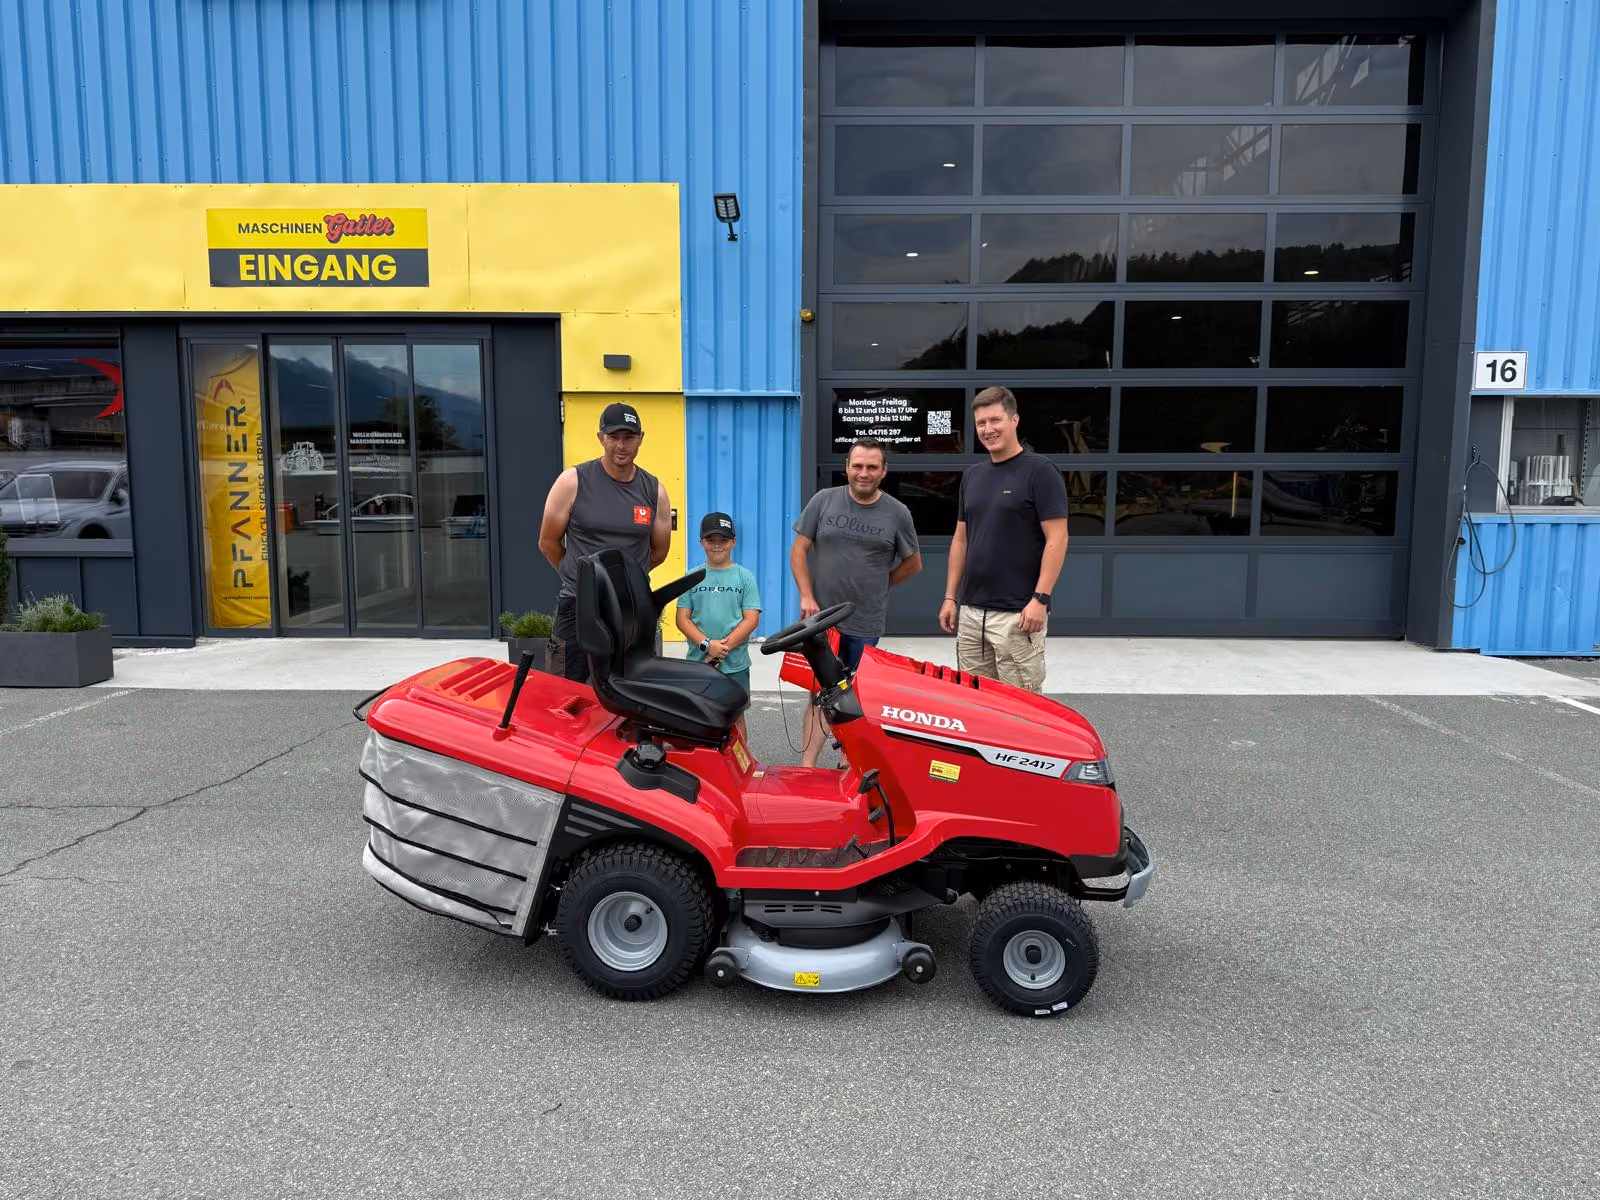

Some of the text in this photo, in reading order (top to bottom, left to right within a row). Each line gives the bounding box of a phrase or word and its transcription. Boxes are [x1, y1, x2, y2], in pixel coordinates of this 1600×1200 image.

[238, 213, 395, 244] MASCHINEN Gailer
[238, 254, 397, 281] EINGANG
[1486, 358, 1517, 383] 16
[848, 398, 876, 407] Montag
[882, 397, 908, 407] Freitag
[842, 415, 874, 423] Samstag
[826, 514, 885, 535] s.Oliver
[690, 586, 742, 594] JORDAN
[881, 705, 968, 733] HONDA
[995, 752, 1056, 770] HF 2417
